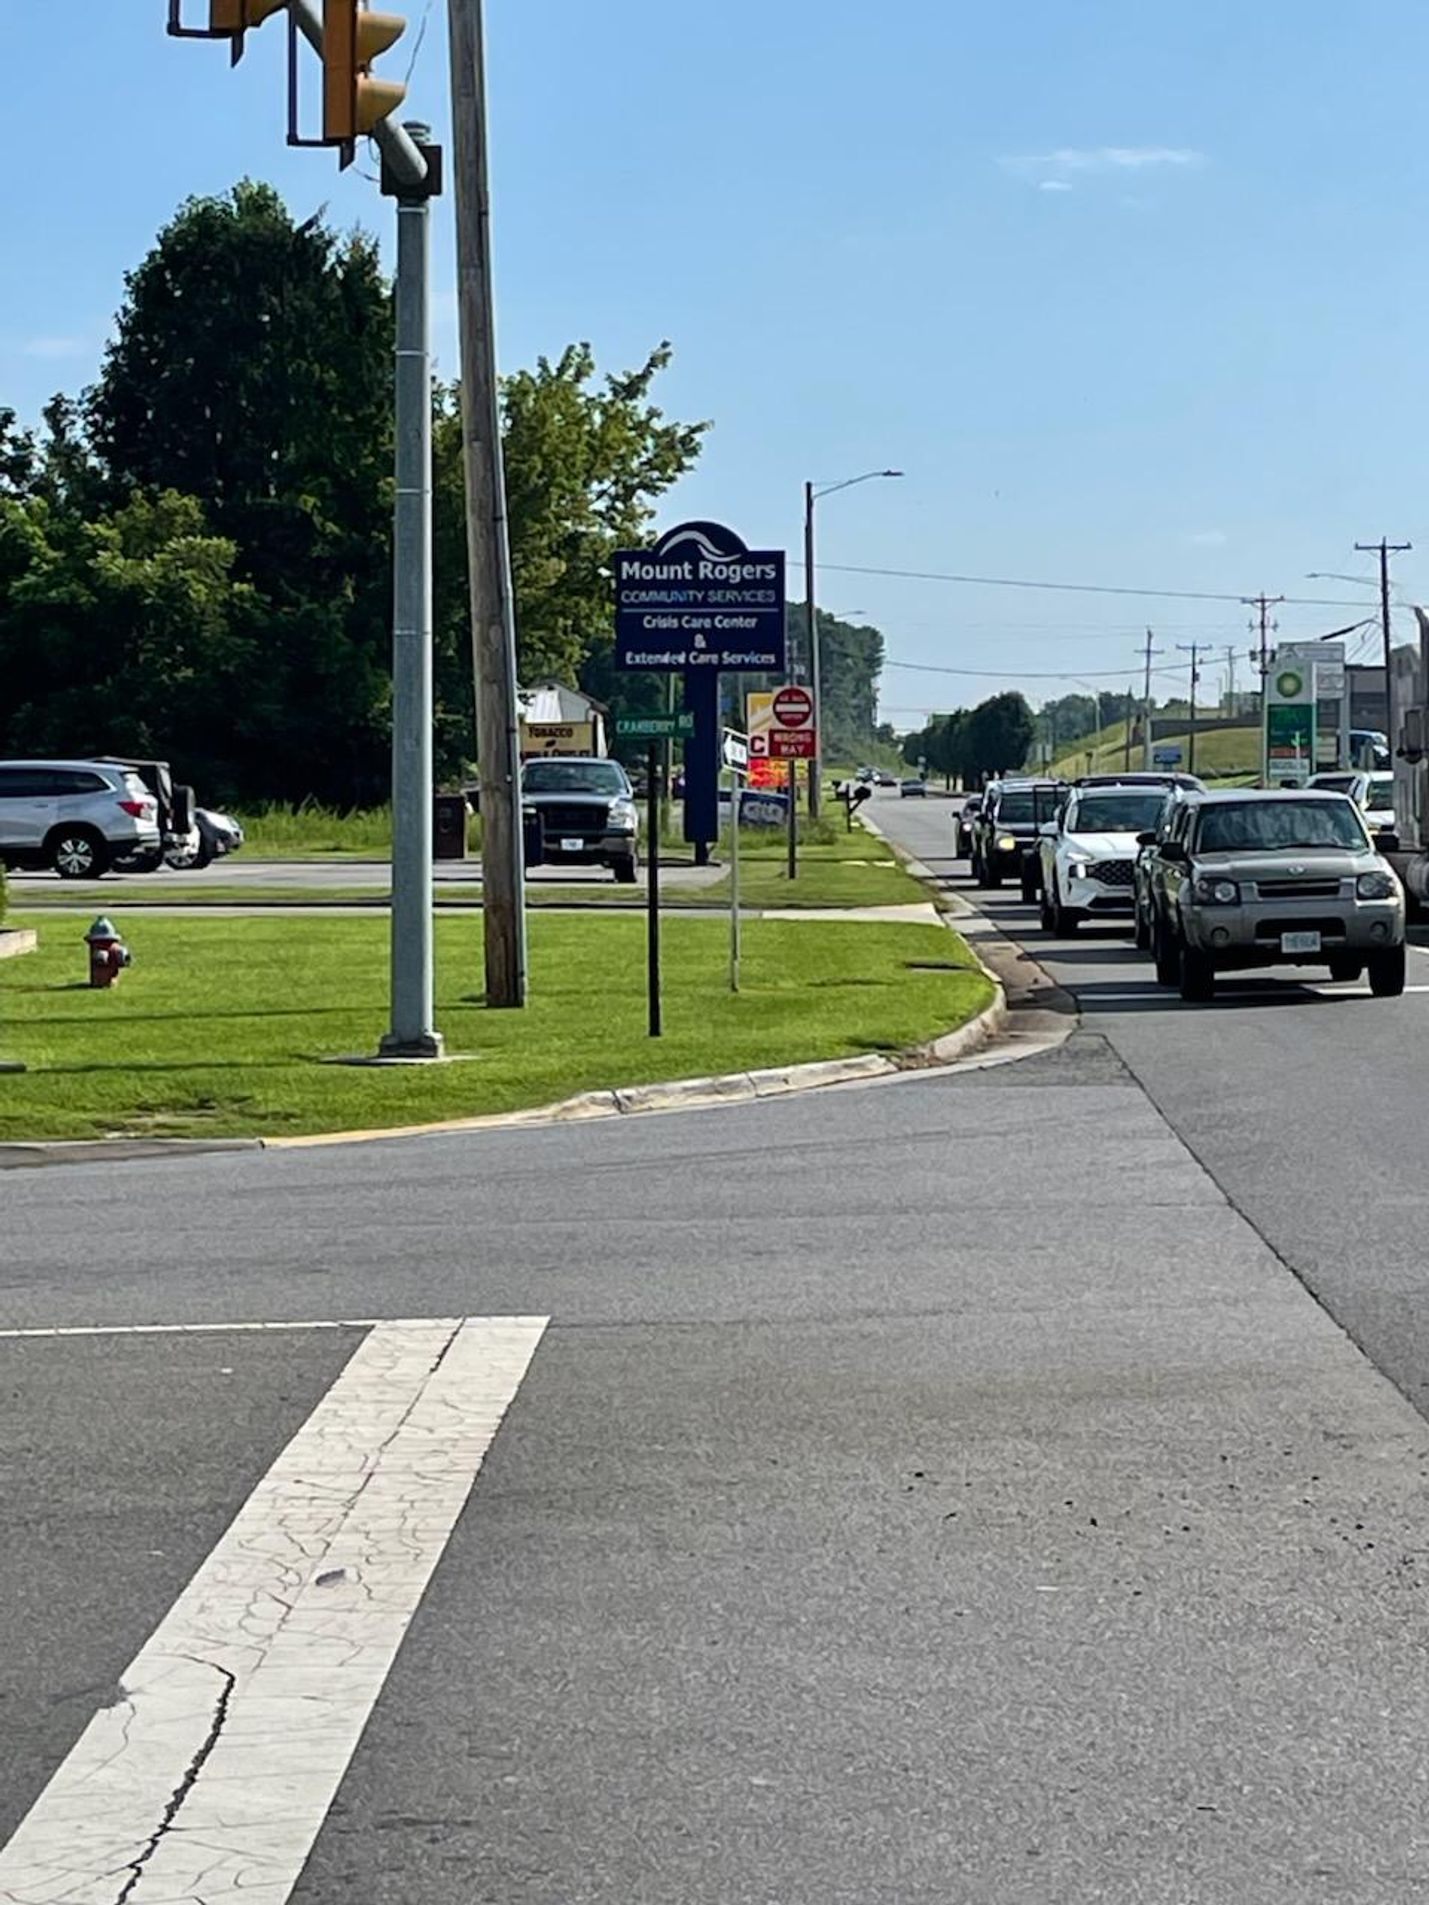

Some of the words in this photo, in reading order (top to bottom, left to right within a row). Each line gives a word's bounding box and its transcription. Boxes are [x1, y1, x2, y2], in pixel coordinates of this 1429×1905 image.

[621, 561, 692, 580] Mount
[699, 561, 776, 584] Rogers
[621, 590, 704, 603] COMMUNITY
[708, 590, 776, 603] SERVICES
[643, 615, 679, 629] Crisis
[681, 615, 712, 629] Care
[714, 615, 757, 629] Center
[694, 633, 707, 649] &
[625, 651, 686, 665] Extended
[688, 651, 718, 665] Care
[722, 651, 776, 665] Services
[527, 726, 574, 739] TOBACCO
[616, 719, 676, 734] CRANBERRY
